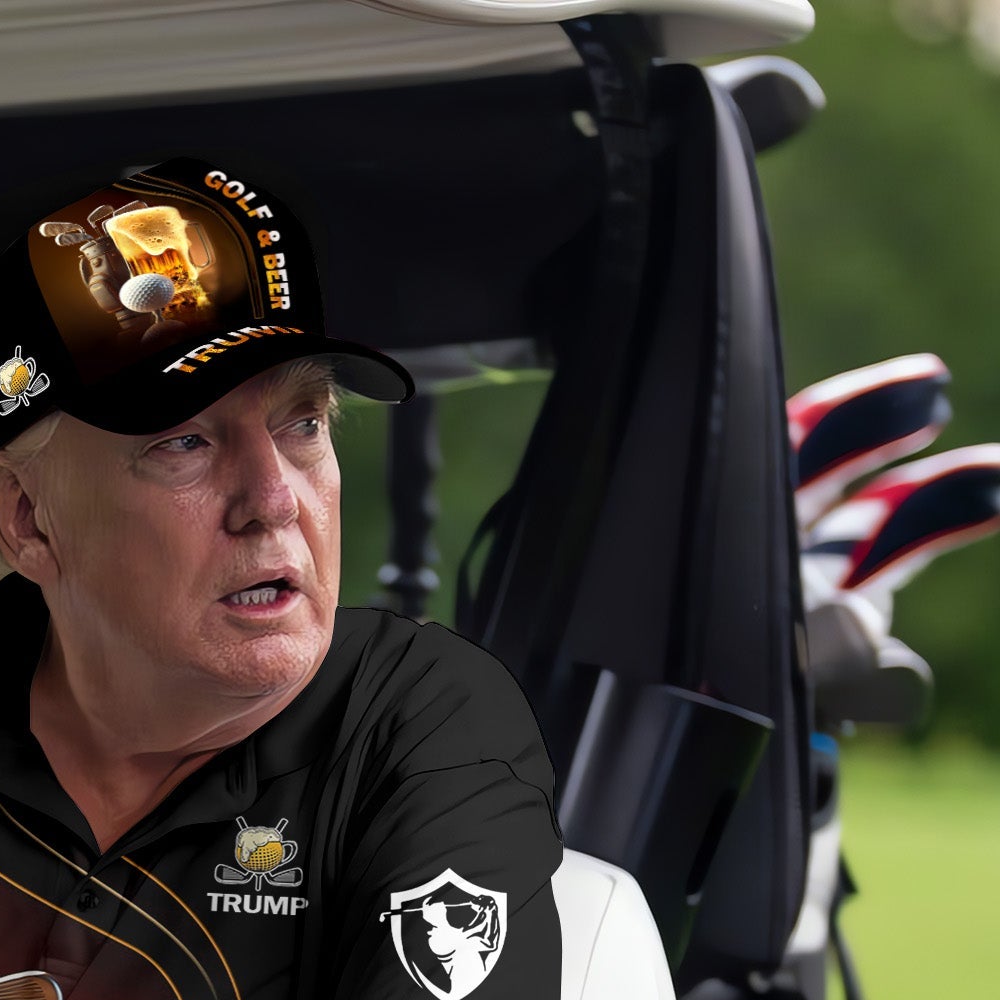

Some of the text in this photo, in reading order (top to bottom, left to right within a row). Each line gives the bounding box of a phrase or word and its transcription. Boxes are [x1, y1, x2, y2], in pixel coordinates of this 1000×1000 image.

[204, 170, 291, 310] GOLF & BEER
[206, 892, 309, 916] TRUMP
